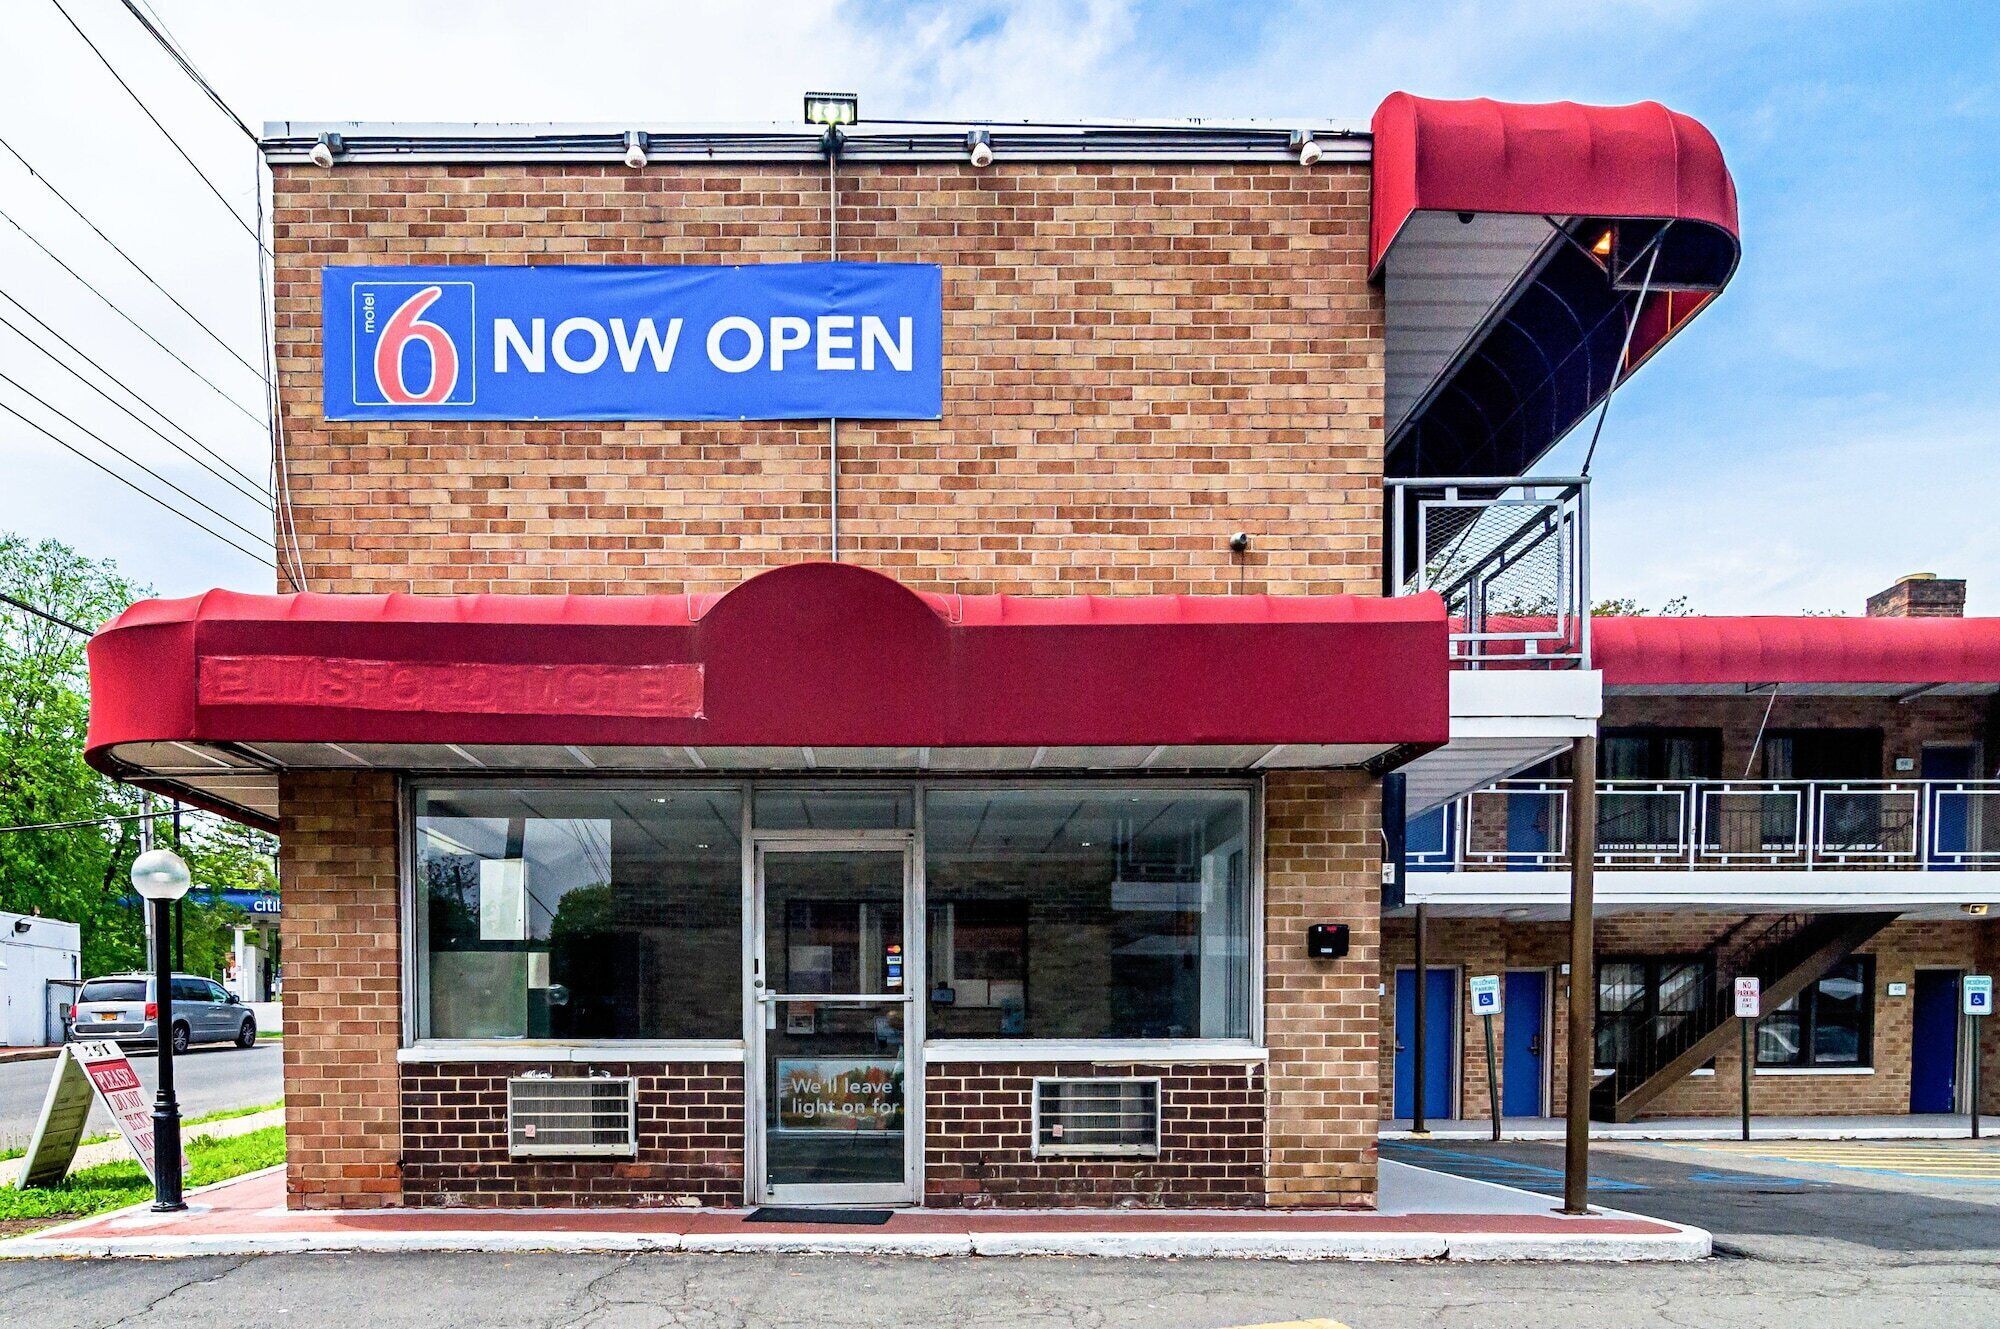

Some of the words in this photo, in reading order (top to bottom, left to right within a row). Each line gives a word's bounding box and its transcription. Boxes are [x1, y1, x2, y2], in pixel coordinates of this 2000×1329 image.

[362, 293, 375, 333] motel
[374, 286, 459, 404] 6
[494, 317, 684, 374] NOW
[706, 315, 913, 373] OPEN
[1742, 981, 1752, 989] NO
[93, 1068, 136, 1091] PLEASE!
[792, 1078, 837, 1094] We'll
[845, 1078, 893, 1094] leave
[112, 1093, 128, 1111] DO
[123, 1091, 144, 1108] NOT
[792, 1098, 836, 1119] light
[842, 1102, 865, 1114] on
[872, 1098, 900, 1114] for
